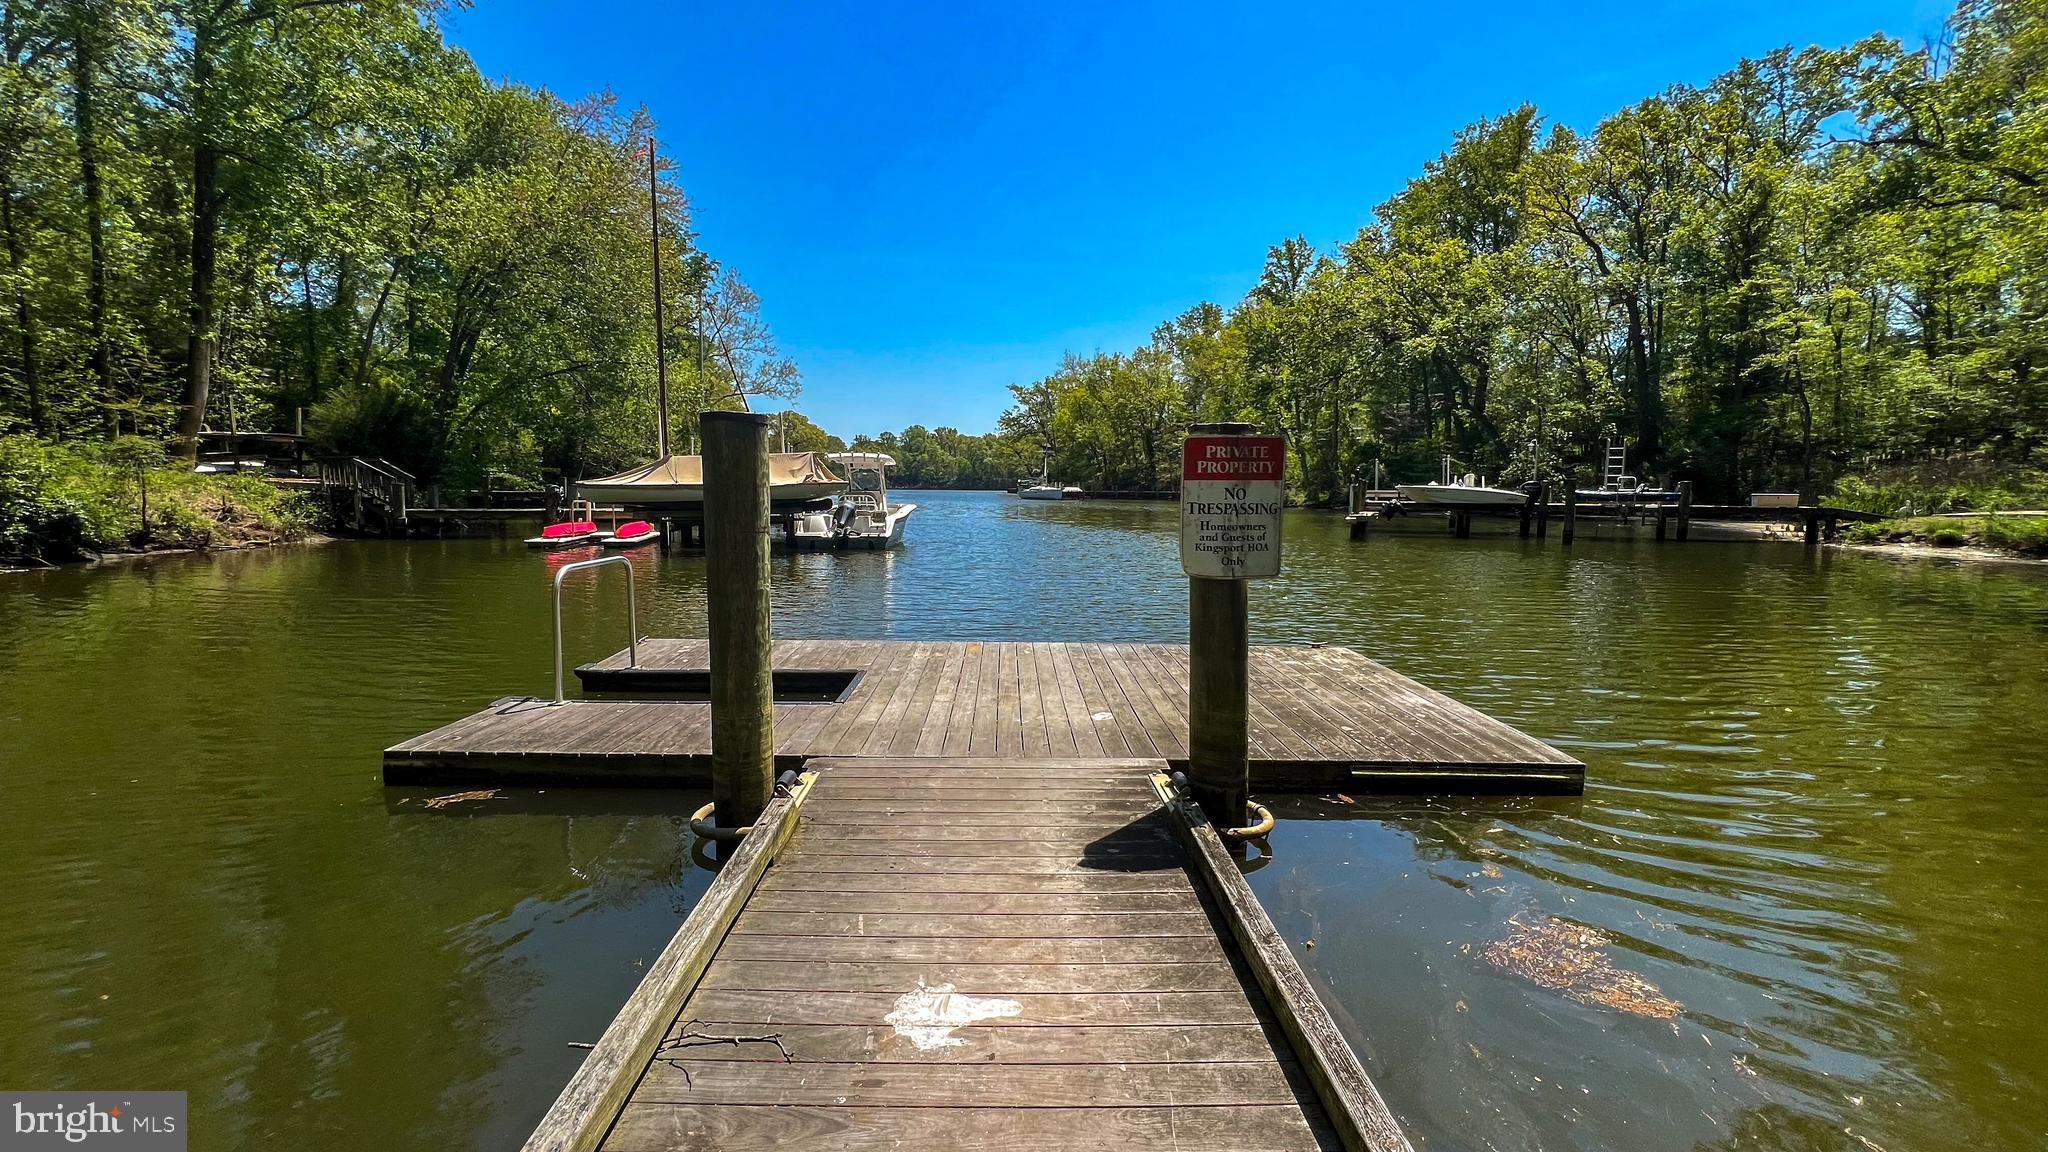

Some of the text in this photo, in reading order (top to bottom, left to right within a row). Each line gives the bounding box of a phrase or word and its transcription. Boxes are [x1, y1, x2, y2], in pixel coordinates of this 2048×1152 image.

[1206, 445, 1269, 458] PRIVATE
[1197, 461, 1275, 474] PROPERTY
[1224, 487, 1247, 500] NO
[1187, 502, 1278, 515] TRESPASSING
[1200, 521, 1266, 531] Homeowners
[1199, 532, 1267, 541] and Guests of
[1195, 543, 1269, 554] Kingsport HOA
[1221, 556, 1246, 567] Only
